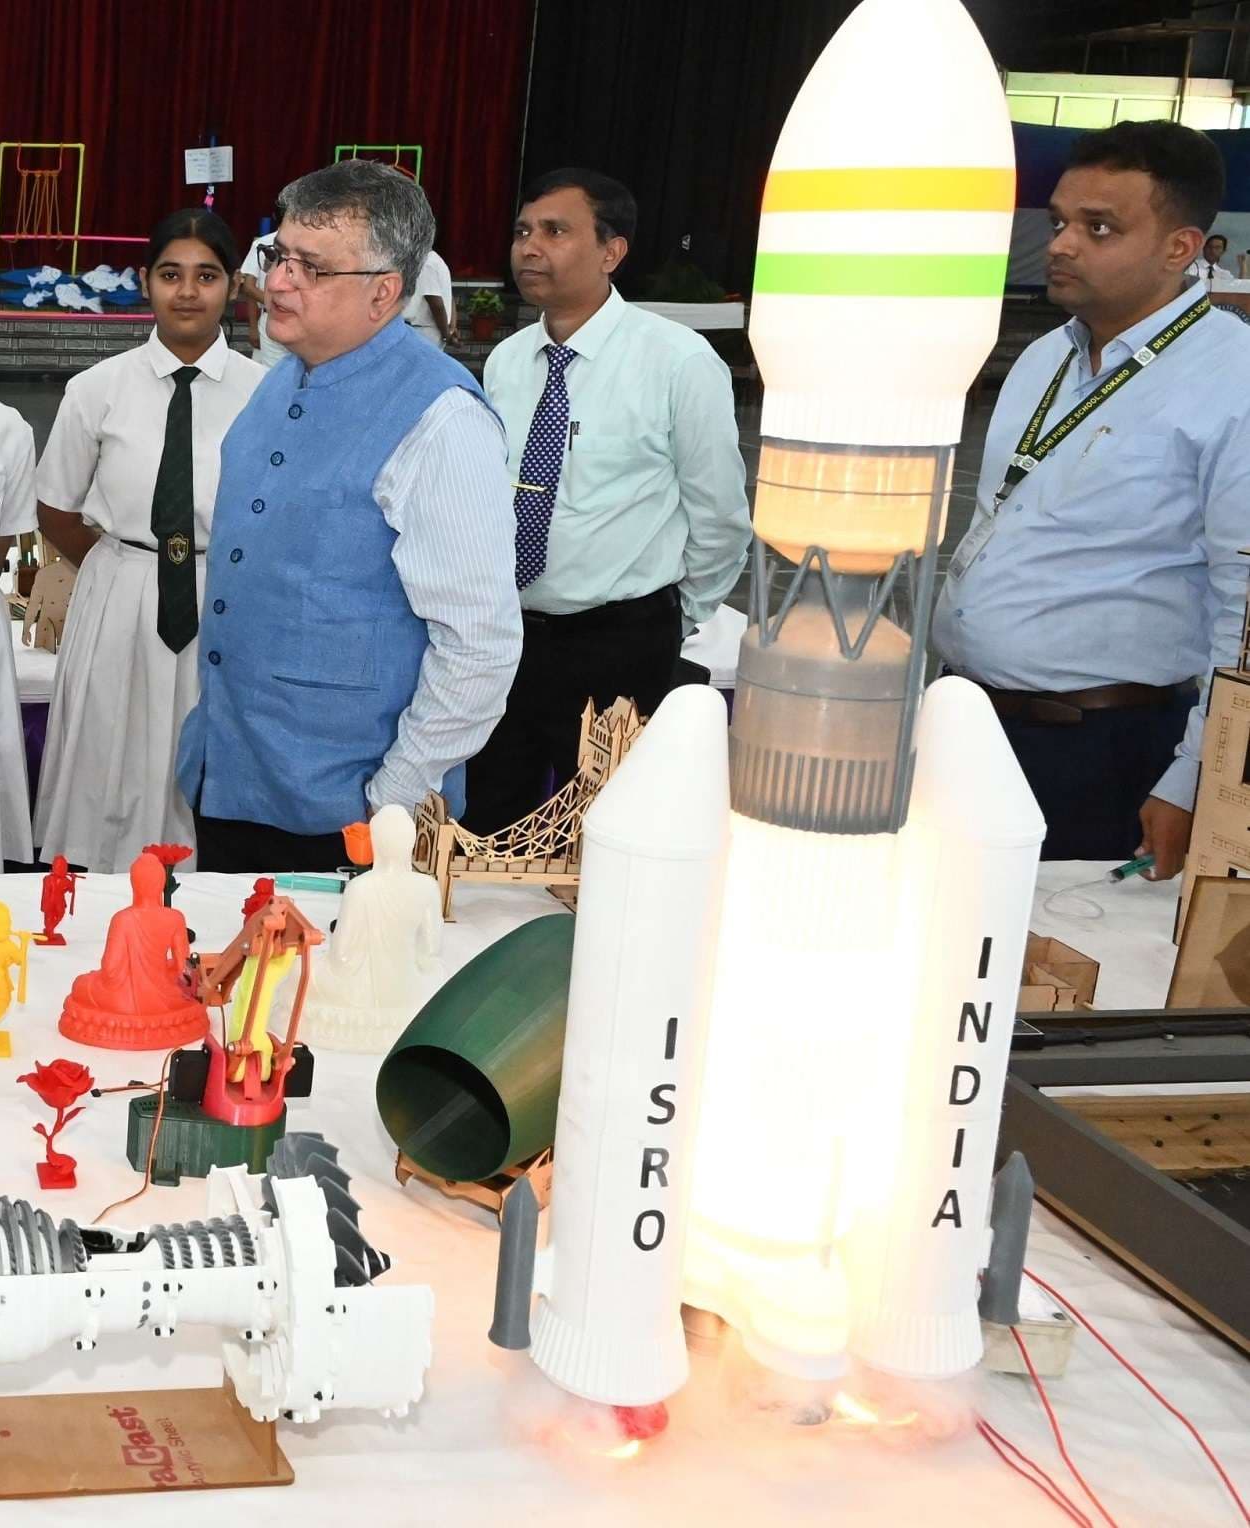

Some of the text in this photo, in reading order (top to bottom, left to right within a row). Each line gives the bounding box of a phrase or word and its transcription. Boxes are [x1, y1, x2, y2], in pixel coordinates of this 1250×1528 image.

[1152, 330, 1174, 349] DELHI
[1173, 311, 1197, 332] PUBLIC
[1020, 433, 1033, 453] DELHI
[1034, 438, 1054, 457] DELHI
[1052, 417, 1076, 440] PUBLIC
[1100, 369, 1130, 395] BOKARO
[931, 936, 993, 1229] INDIA
[633, 1017, 678, 1252] ISRO
